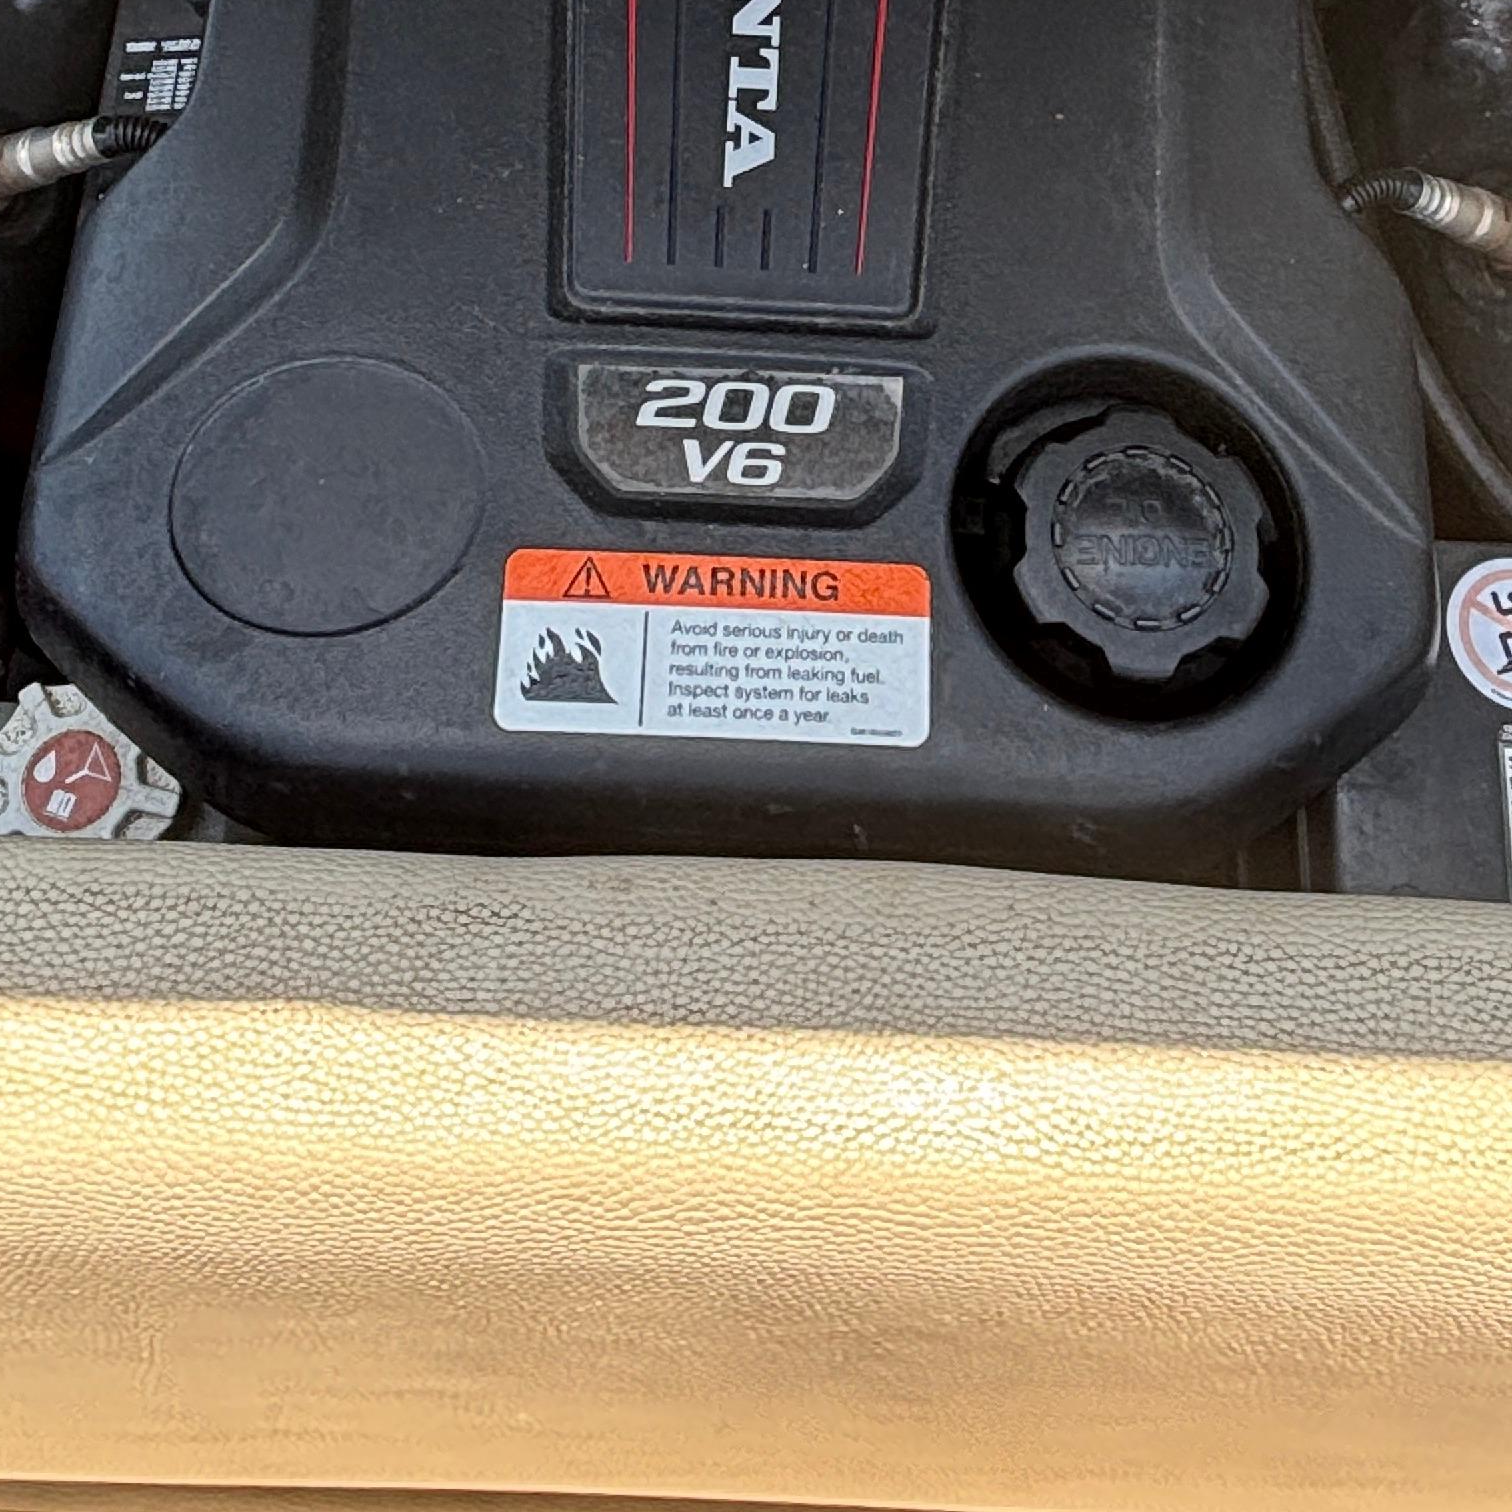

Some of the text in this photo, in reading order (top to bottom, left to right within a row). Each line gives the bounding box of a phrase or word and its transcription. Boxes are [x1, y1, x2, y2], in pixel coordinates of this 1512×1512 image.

[636, 379, 836, 434] 200
[683, 439, 786, 486] V6
[1076, 534, 1210, 568] ENGINE
[642, 564, 840, 602] WARNING
[671, 619, 904, 645] Avoid serious injury or death
[670, 639, 849, 663] from fire or explosion,
[668, 662, 738, 681] resulting
[744, 663, 782, 679] from
[787, 665, 845, 685] leaking
[668, 681, 870, 704] Inspect system for leaks
[667, 702, 683, 717] at
[689, 702, 727, 719] least
[732, 707, 774, 720] once
[778, 710, 788, 721] a
